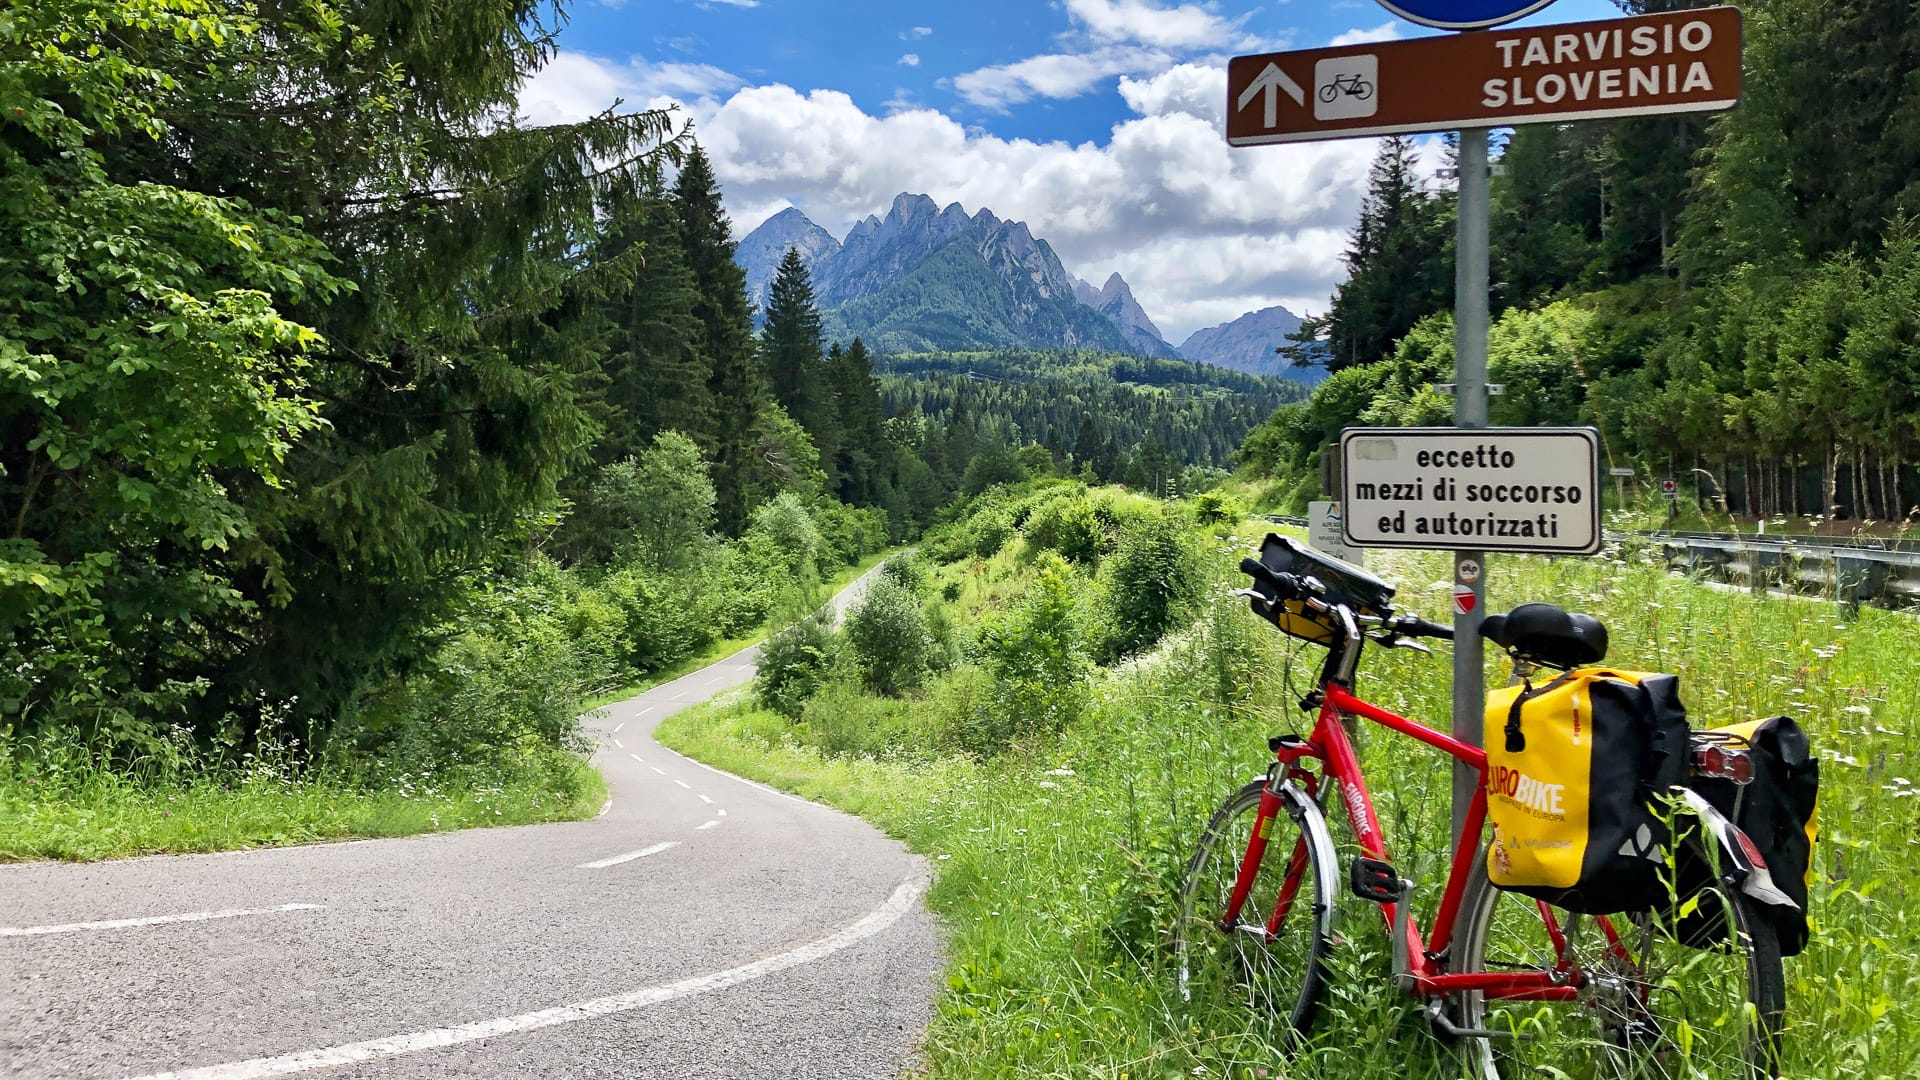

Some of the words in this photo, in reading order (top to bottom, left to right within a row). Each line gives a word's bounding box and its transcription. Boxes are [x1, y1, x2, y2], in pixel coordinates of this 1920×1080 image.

[1495, 20, 1713, 69] TARVISIO
[1481, 61, 1714, 109] SLOVENIA
[1416, 444, 1515, 469] eccetto
[1355, 476, 1423, 501] mezzi
[1432, 476, 1456, 502] di
[1465, 484, 1582, 504] soccorso
[1377, 509, 1406, 534] ed
[1414, 511, 1558, 539] autorizzati
[1344, 781, 1372, 836] EUROBIKE
